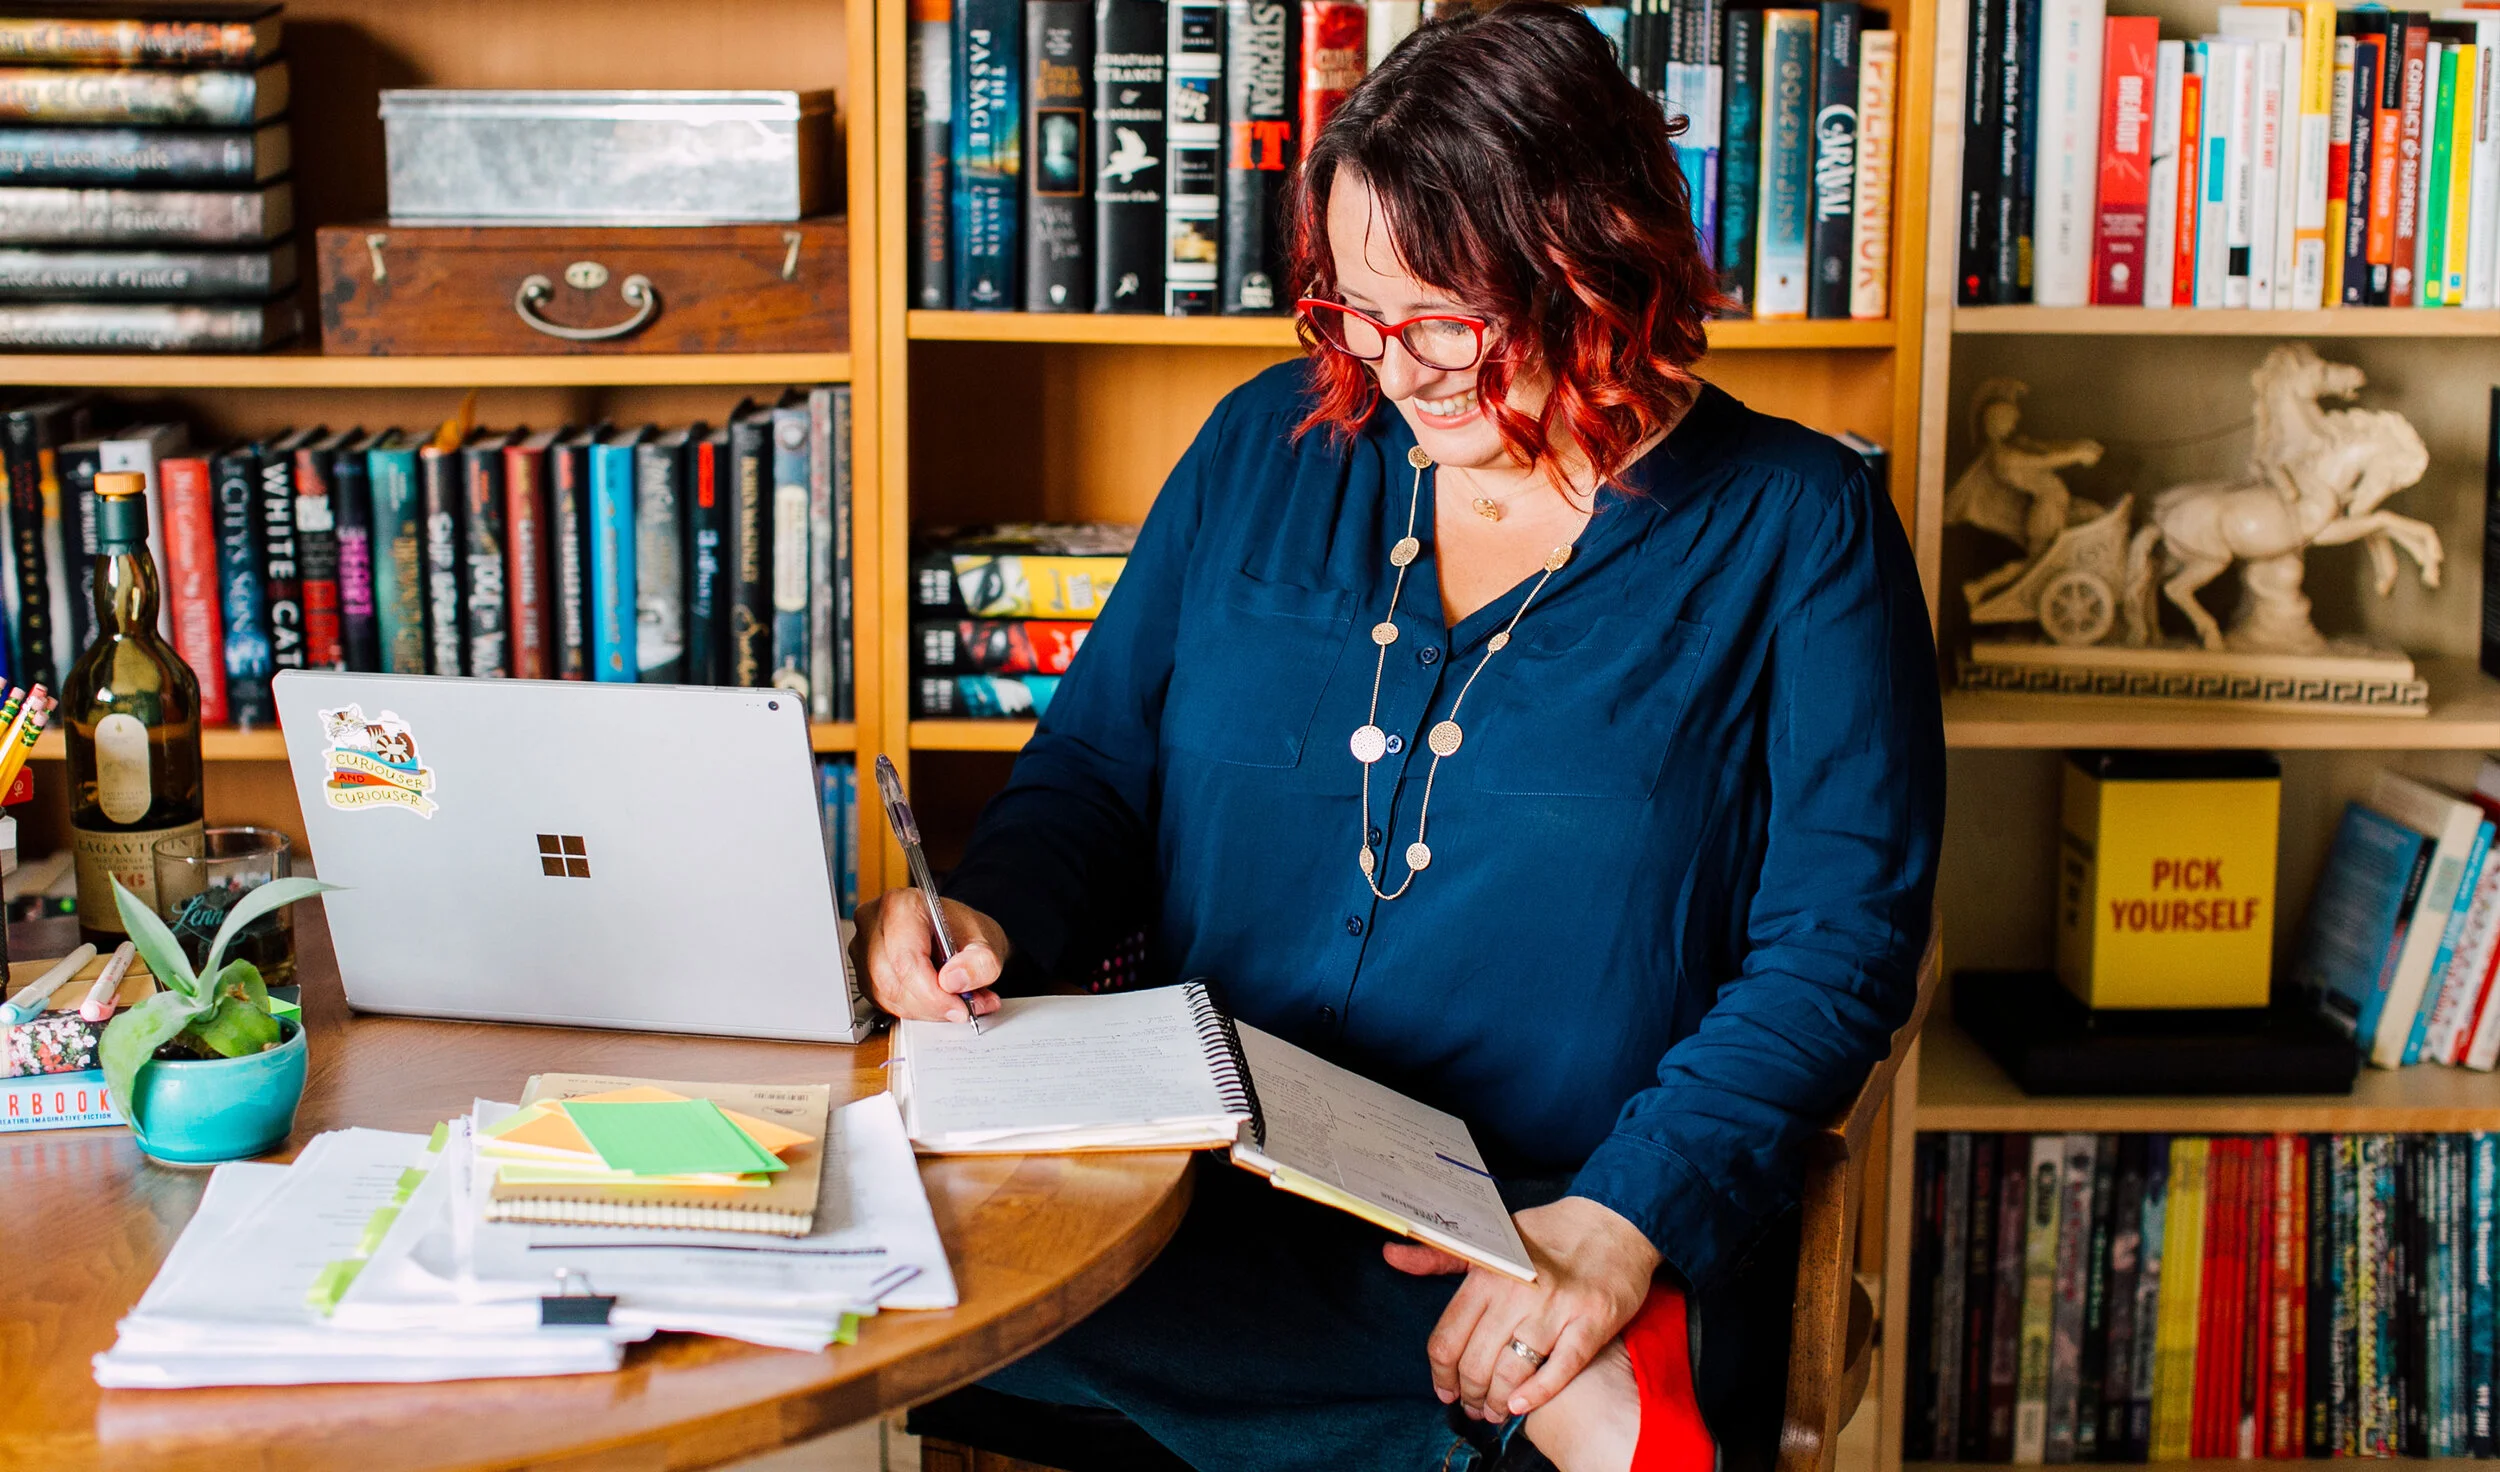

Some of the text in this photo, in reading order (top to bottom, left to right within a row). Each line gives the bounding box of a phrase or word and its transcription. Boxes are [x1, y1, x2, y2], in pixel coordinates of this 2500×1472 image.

[969, 28, 991, 148] PASSAGE
[990, 65, 1007, 111] THE
[1235, 3, 1286, 117] STEPHEN KING
[2383, 114, 2399, 143] Plot
[2404, 57, 2424, 138] CONFLICT
[1228, 120, 1291, 172] IT
[1815, 103, 1857, 222] CARAVAL
[927, 150, 948, 263] American
[969, 185, 985, 257] CRONIN
[986, 187, 1000, 257] JUSTIN
[2377, 157, 2395, 218] Structure
[2397, 160, 2419, 240] SUSPENSE
[261, 462, 304, 670] WHITE CAT
[340, 536, 373, 616] HEART
[338, 772, 366, 784] AND
[2151, 857, 2224, 892] PICK
[2110, 898, 2260, 933] YOURSELF
[32, 1115, 81, 1124] IMAGINATIVE
[83, 1112, 112, 1121] FICTION
